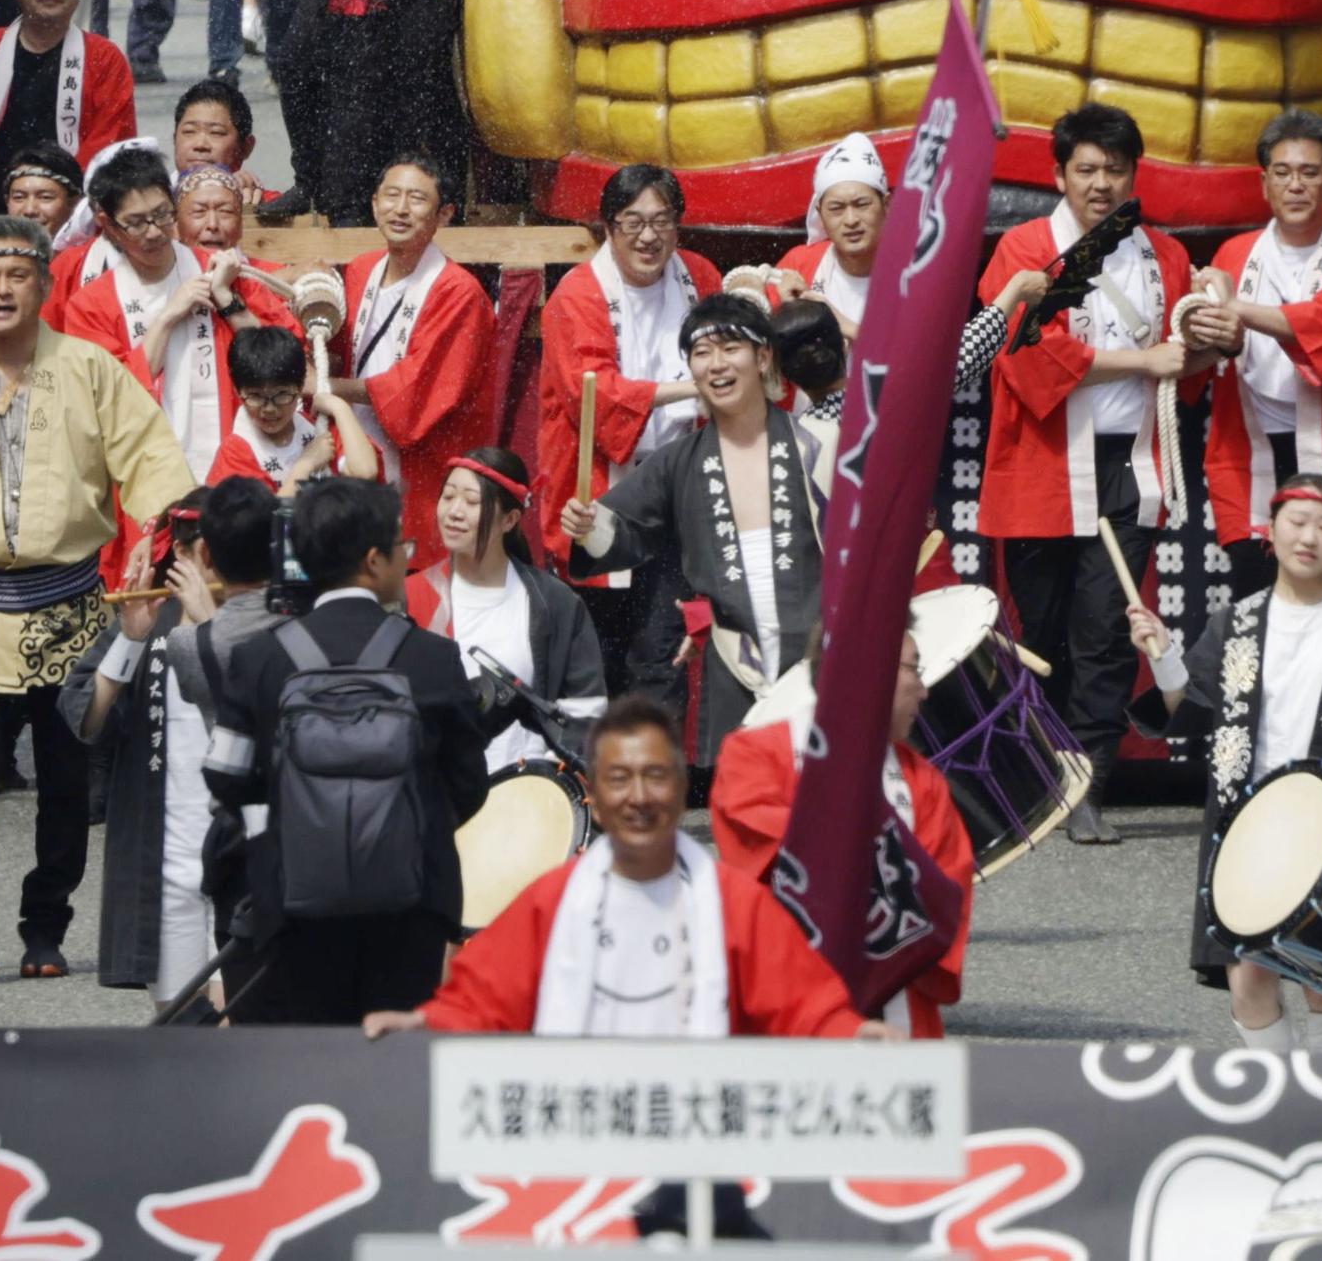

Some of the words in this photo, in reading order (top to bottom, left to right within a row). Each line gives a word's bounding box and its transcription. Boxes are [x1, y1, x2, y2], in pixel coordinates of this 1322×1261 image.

[62, 56, 81, 147] 城島まつり
[703, 454, 745, 583] 城島大獅子会
[769, 440, 794, 572] 城島大獅子会
[460, 1077, 937, 1139] 久留米市城島大獅子どんたく隊
